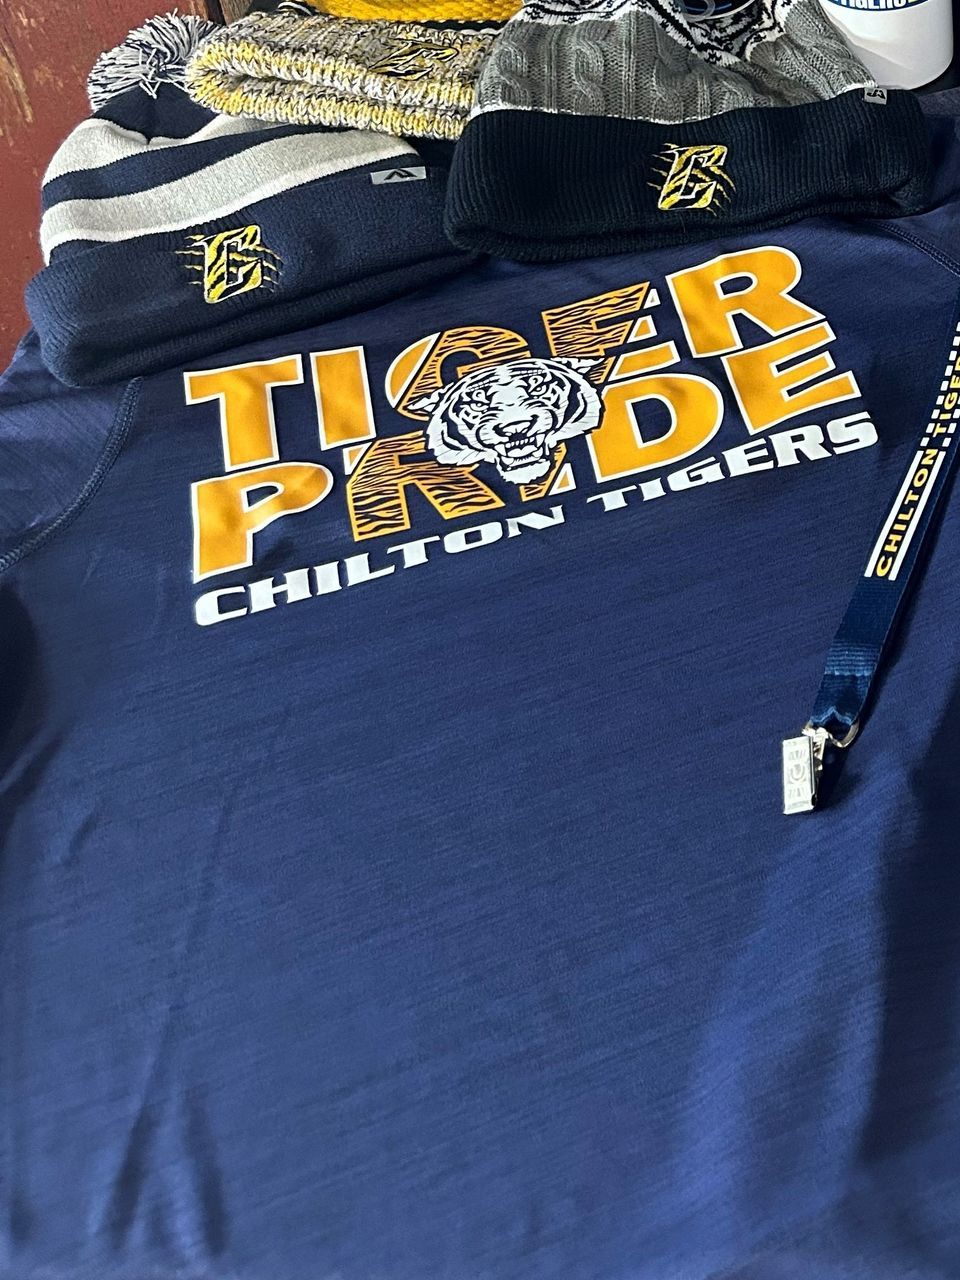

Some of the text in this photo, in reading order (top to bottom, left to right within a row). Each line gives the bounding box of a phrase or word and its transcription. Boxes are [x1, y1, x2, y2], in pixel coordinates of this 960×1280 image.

[183, 244, 828, 472] TIGER
[194, 412, 878, 626] CHILTON TIGERS
[875, 448, 939, 577] CHILTON
